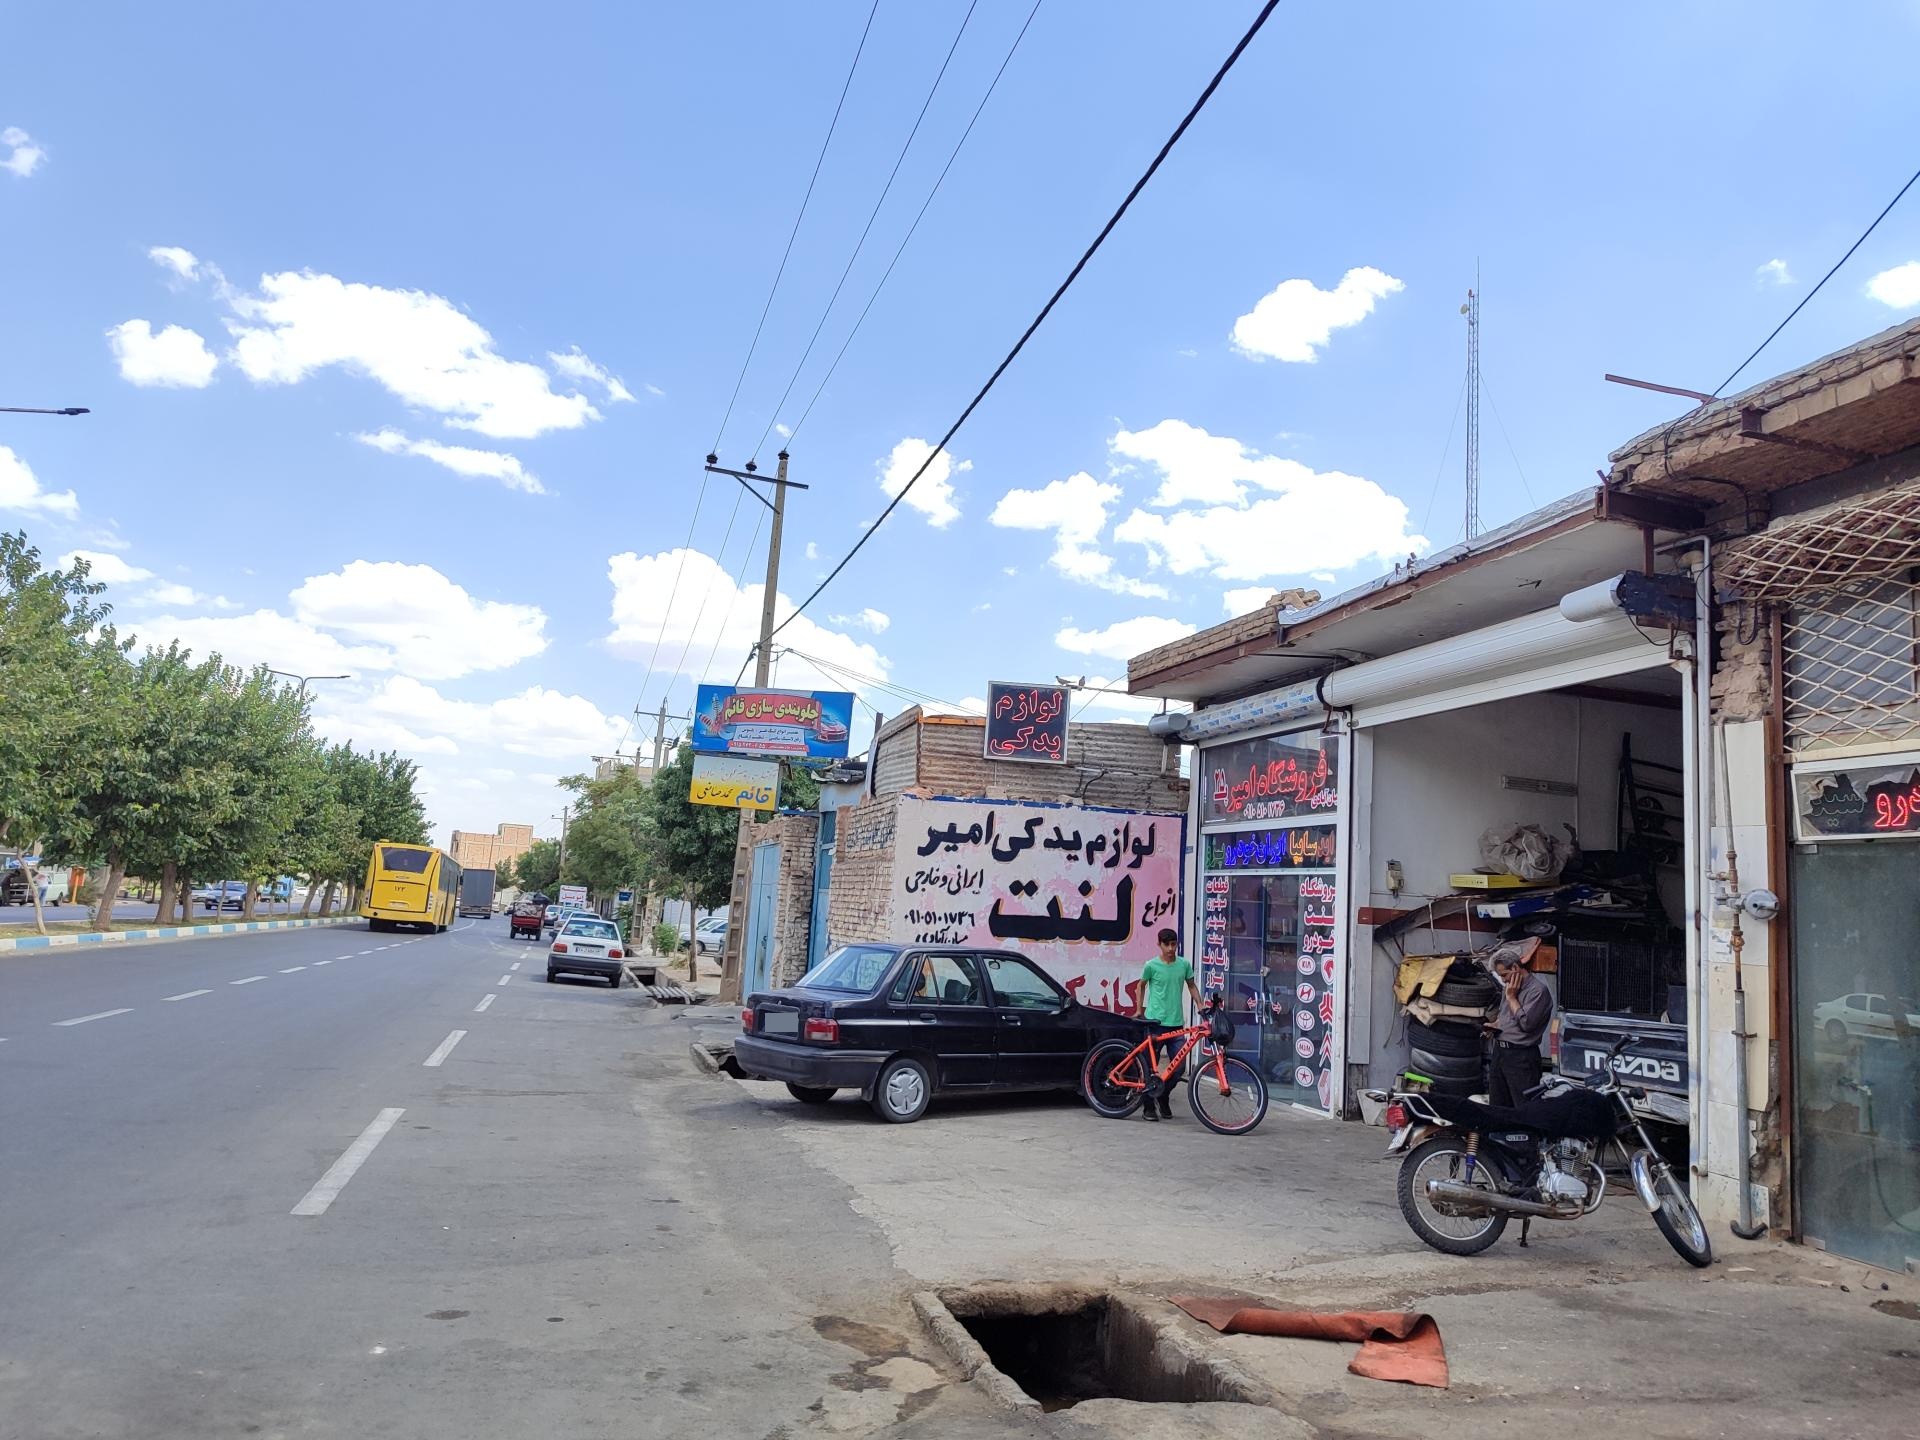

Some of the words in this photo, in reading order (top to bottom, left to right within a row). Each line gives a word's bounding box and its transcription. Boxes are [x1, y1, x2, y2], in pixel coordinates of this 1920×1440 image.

[725, 697, 745, 720] قائم
[746, 698, 773, 719] سازی
[775, 703, 818, 724] جلوبندی
[995, 690, 1063, 723] لوازم
[990, 726, 1061, 760] یدکی
[1227, 765, 1256, 812] امیر
[1257, 749, 1327, 802] فروشگاه
[736, 786, 772, 807] قائم
[917, 811, 995, 857] امیر
[991, 816, 1082, 862] یدکی
[1086, 822, 1156, 869] لوازم
[1224, 833, 1257, 866] خودرو
[1257, 831, 1288, 865] ایران
[1289, 830, 1318, 865] سایپا
[905, 867, 941, 894] خارجی
[948, 865, 984, 896] ایرانی
[1206, 876, 1229, 894] قطعات
[904, 911, 975, 928] ۰۹۱۰۵۱۰۱۷۳۶
[989, 874, 1133, 943] لنت
[1142, 888, 1177, 928] انواع
[1304, 902, 1336, 926] لنت
[1303, 929, 1336, 955] خودرو
[1206, 967, 1225, 990] پژو
